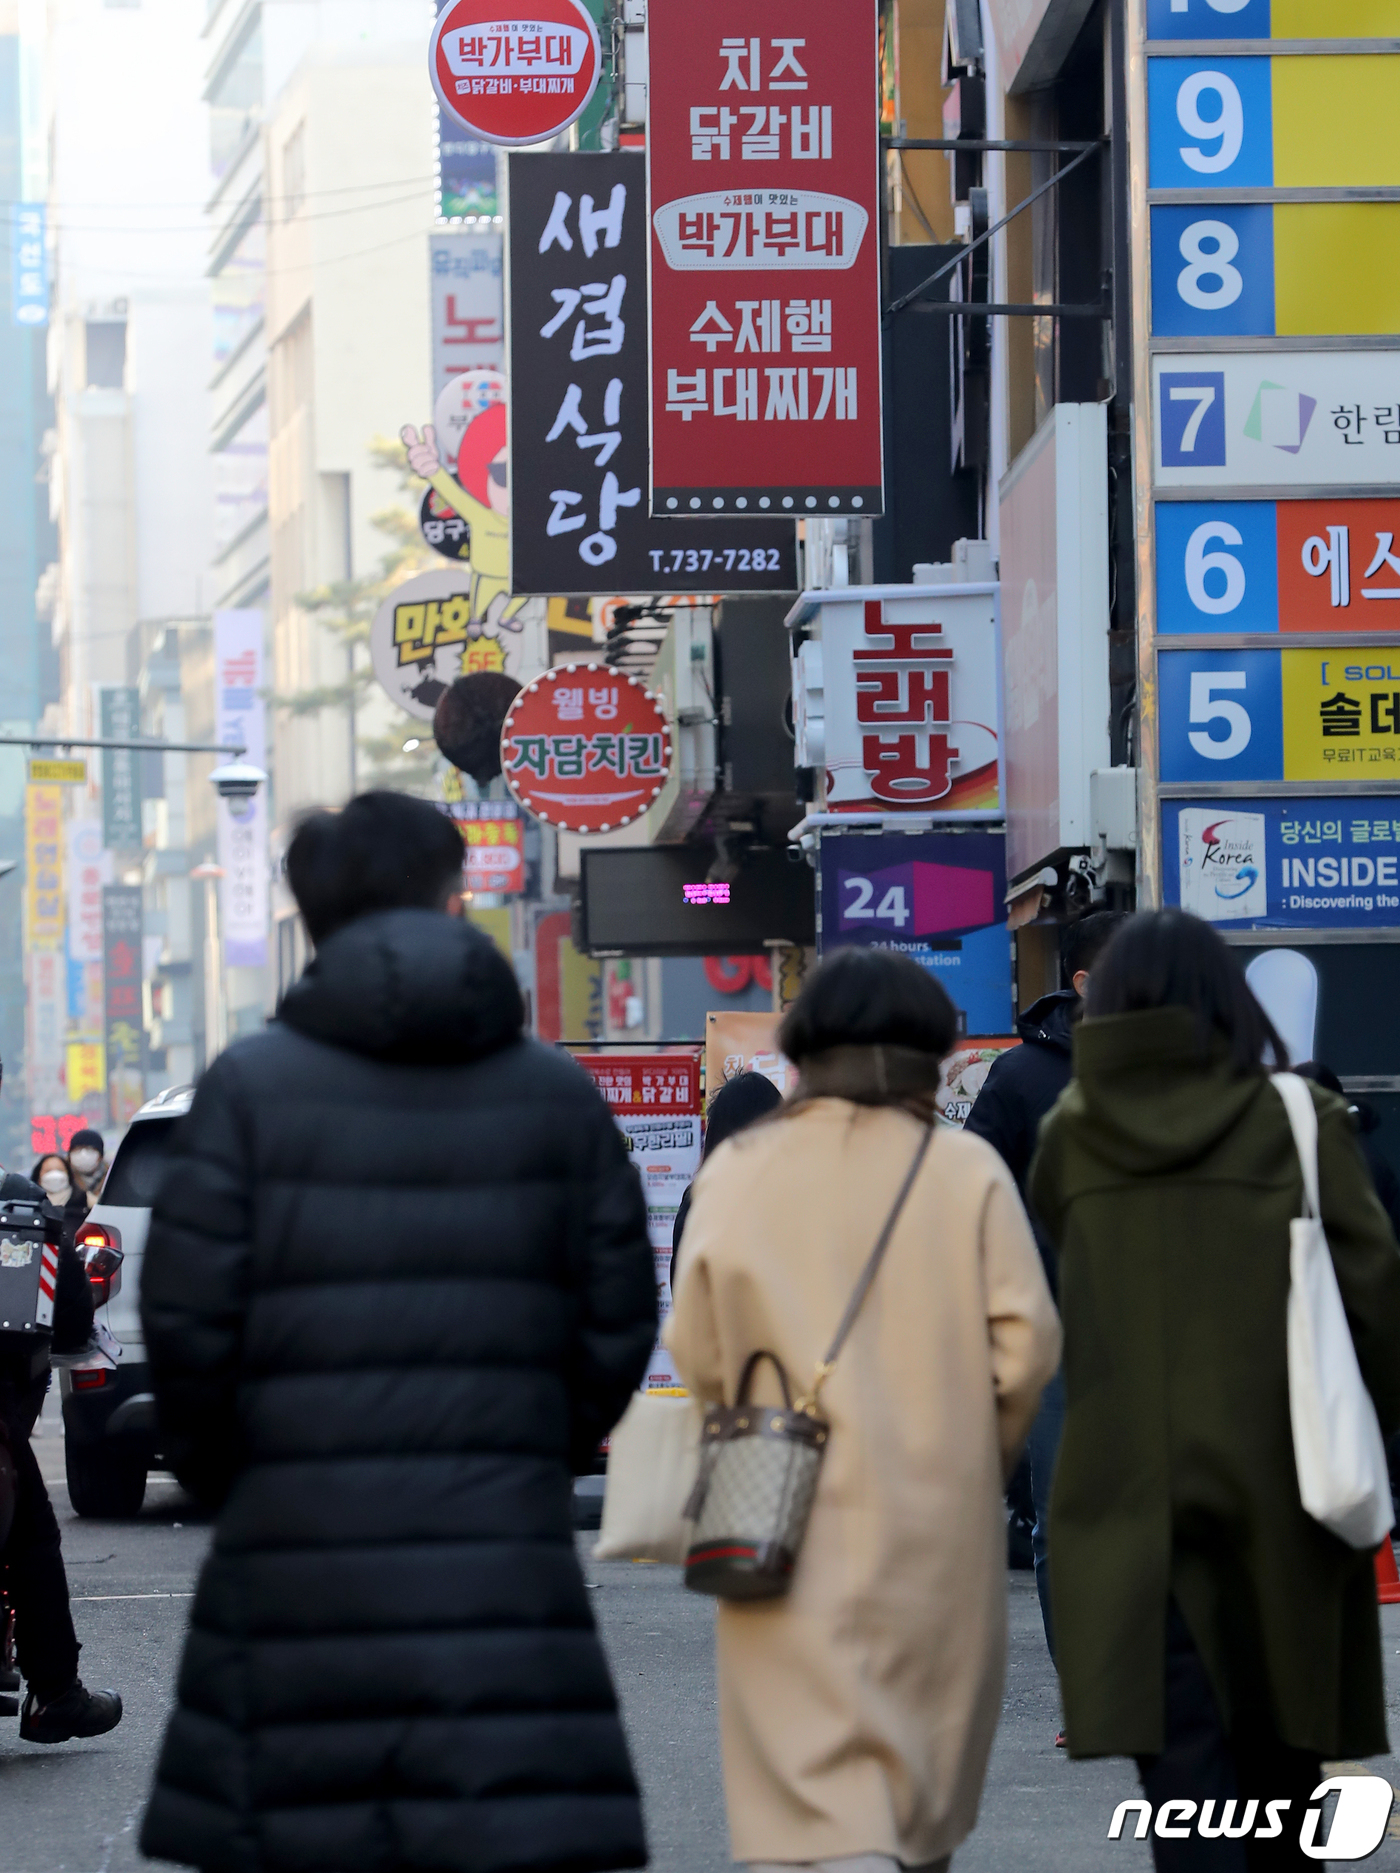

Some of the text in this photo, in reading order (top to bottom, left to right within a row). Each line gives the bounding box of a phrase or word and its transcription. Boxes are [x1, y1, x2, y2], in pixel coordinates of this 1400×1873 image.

[458, 35, 572, 67] 박가부대
[718, 37, 808, 91] 치즈
[689, 105, 832, 161] 닭갈비
[1176, 70, 1244, 174] 9
[768, 193, 798, 206] 맛있는
[678, 211, 843, 257] 박가부대
[1176, 219, 1244, 310] 8
[689, 299, 832, 353] 수제햄
[665, 366, 858, 422] 부대찌개
[1169, 386, 1216, 452] 7
[423, 519, 470, 545] 당구
[649, 549, 781, 574] T.737-7282
[1184, 520, 1246, 615] 6
[552, 687, 620, 720] 웰빙
[853, 600, 960, 802] 노래방
[1187, 671, 1252, 760] 5
[510, 733, 664, 780] 자담치킨
[1323, 747, 1400, 763] 무료IT교육
[1224, 839, 1254, 851] Inside
[1280, 820, 1342, 845] 당신의
[1201, 840, 1254, 870] Korea
[1281, 856, 1399, 888] INSIDE
[843, 876, 910, 927] 24
[1290, 894, 1374, 911] Discovering
[1376, 894, 1400, 907] the
[889, 940, 930, 953] hours
[600, 1086, 632, 1103] 찌개
